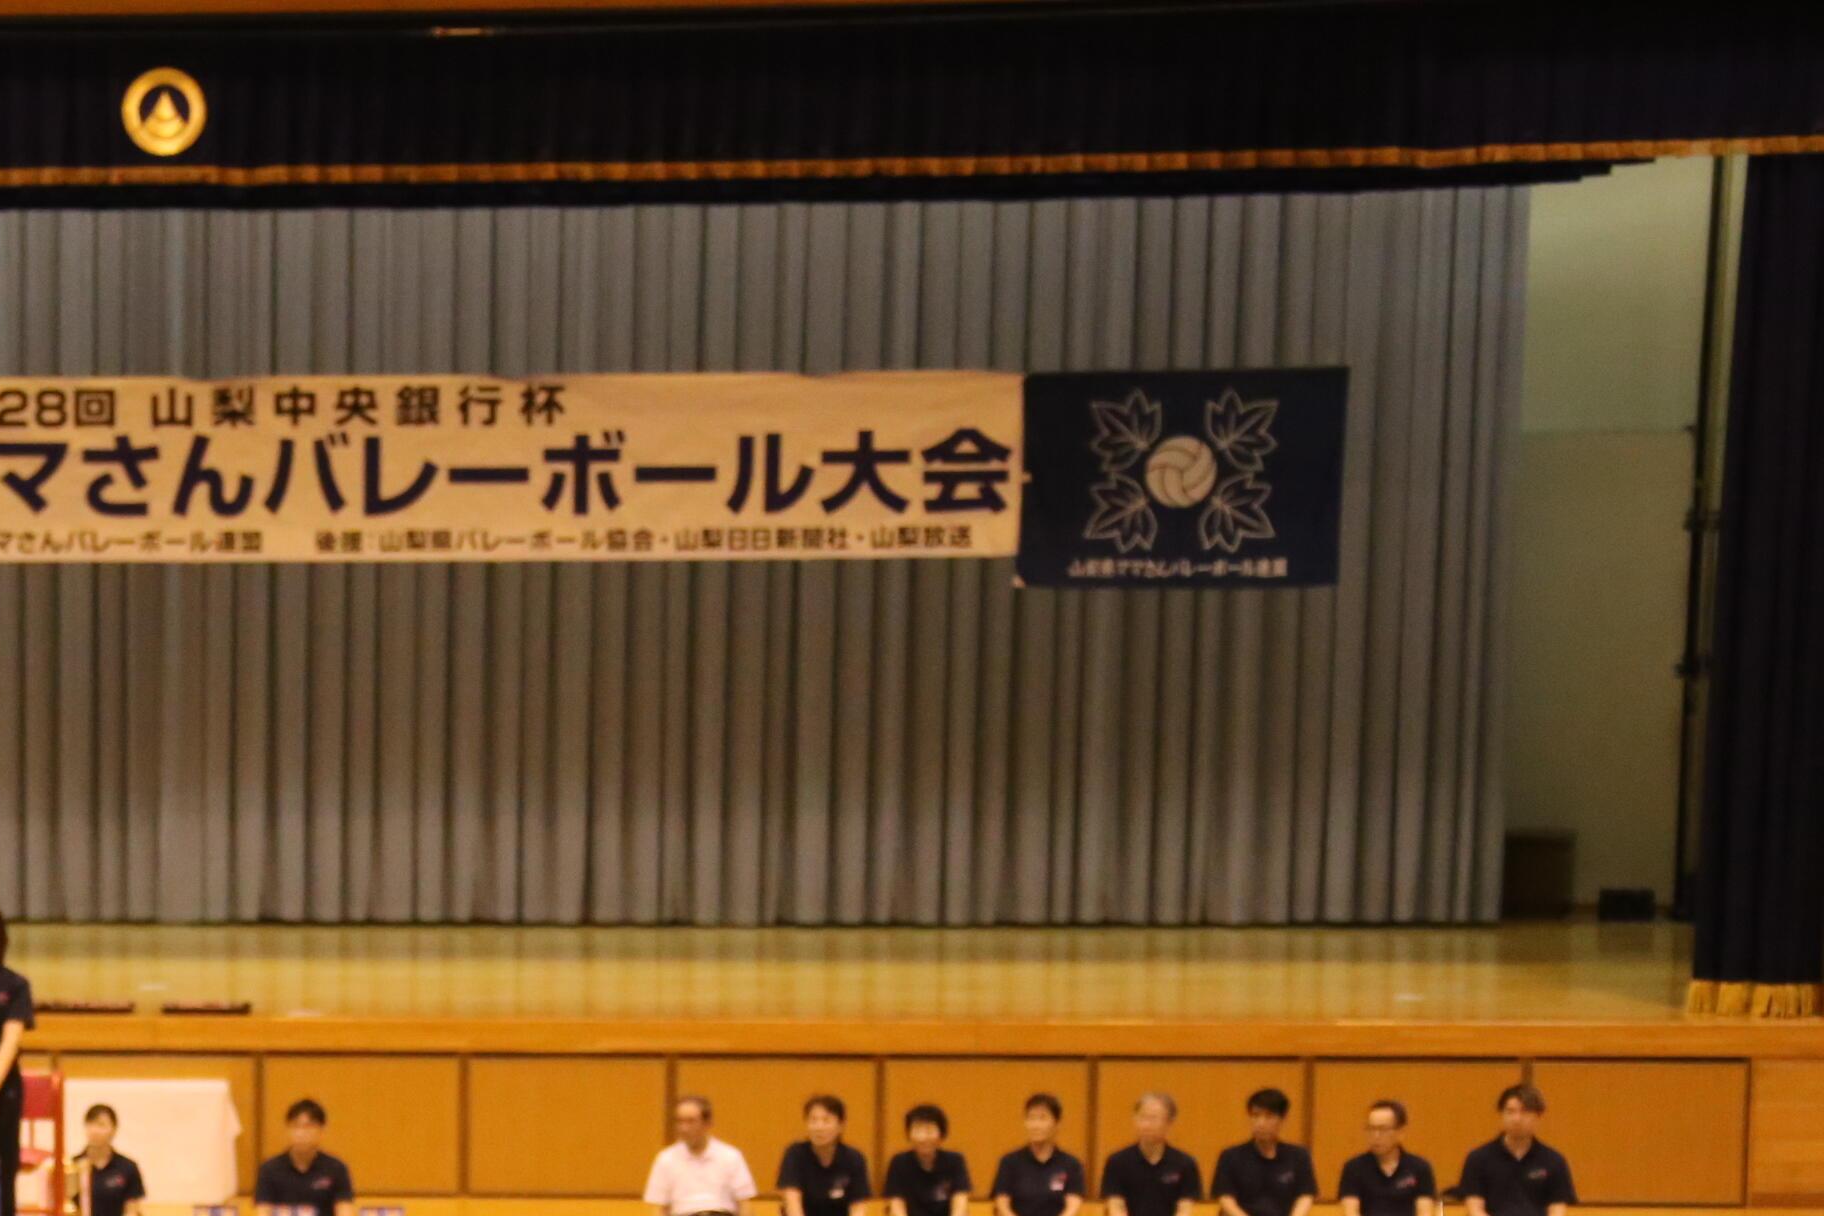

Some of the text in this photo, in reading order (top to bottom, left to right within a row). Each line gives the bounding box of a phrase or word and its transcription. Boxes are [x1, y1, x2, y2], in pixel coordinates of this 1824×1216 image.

[151, 385, 567, 427] 山梨中央銀行杯
